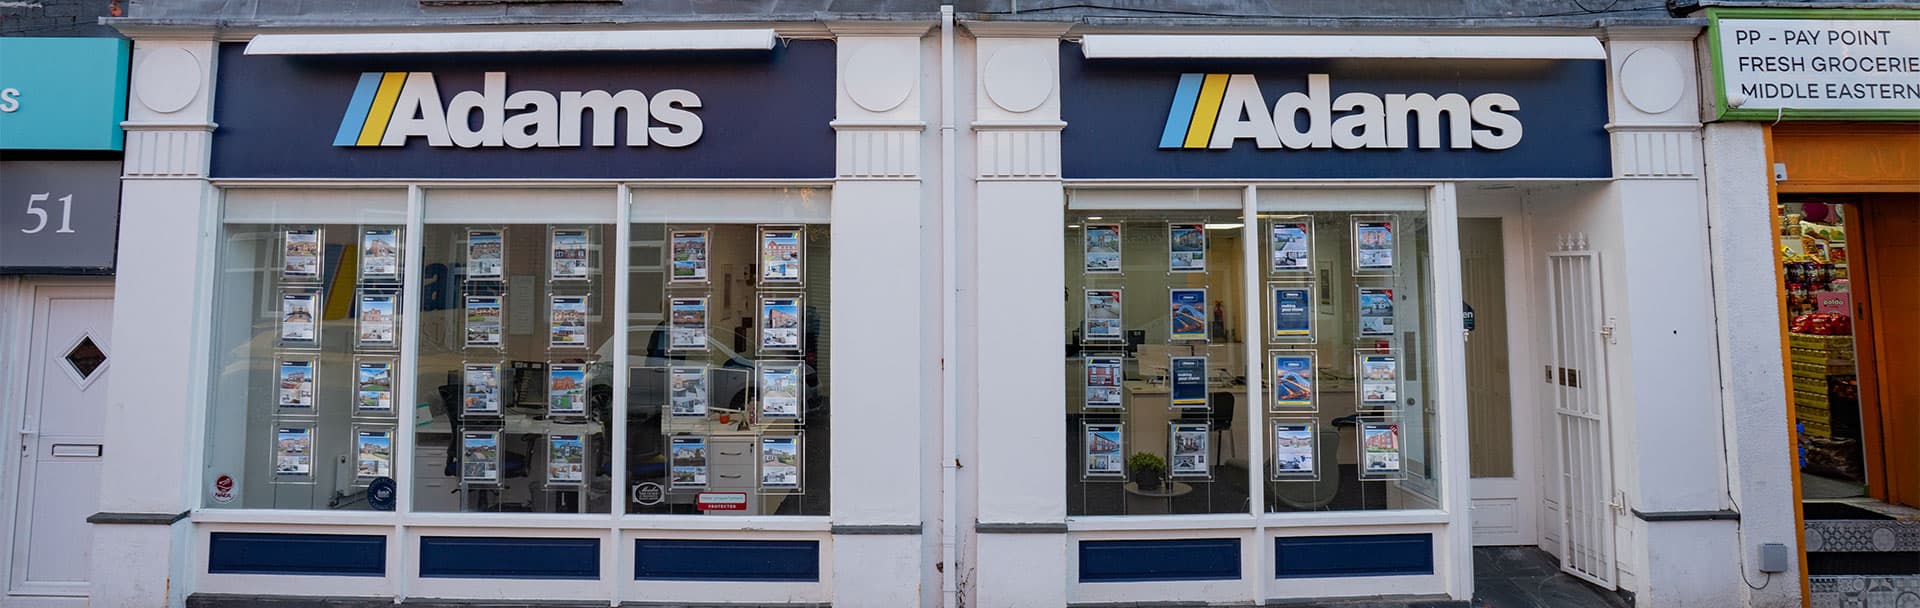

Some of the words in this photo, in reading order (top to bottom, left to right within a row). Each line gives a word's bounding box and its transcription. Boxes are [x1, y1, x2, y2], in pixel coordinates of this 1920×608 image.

[1735, 29, 1761, 46] PP
[1783, 29, 1820, 46] PAY
[1827, 29, 1891, 46] POINT
[1738, 56, 1805, 73] FRESH
[1811, 56, 1920, 73] GROCERIE
[1741, 83, 1820, 99] MIDDLE
[1825, 83, 1920, 99] EASTERN
[380, 71, 704, 149] Adams
[1208, 73, 1523, 150] Adams
[20, 191, 76, 234] 51
